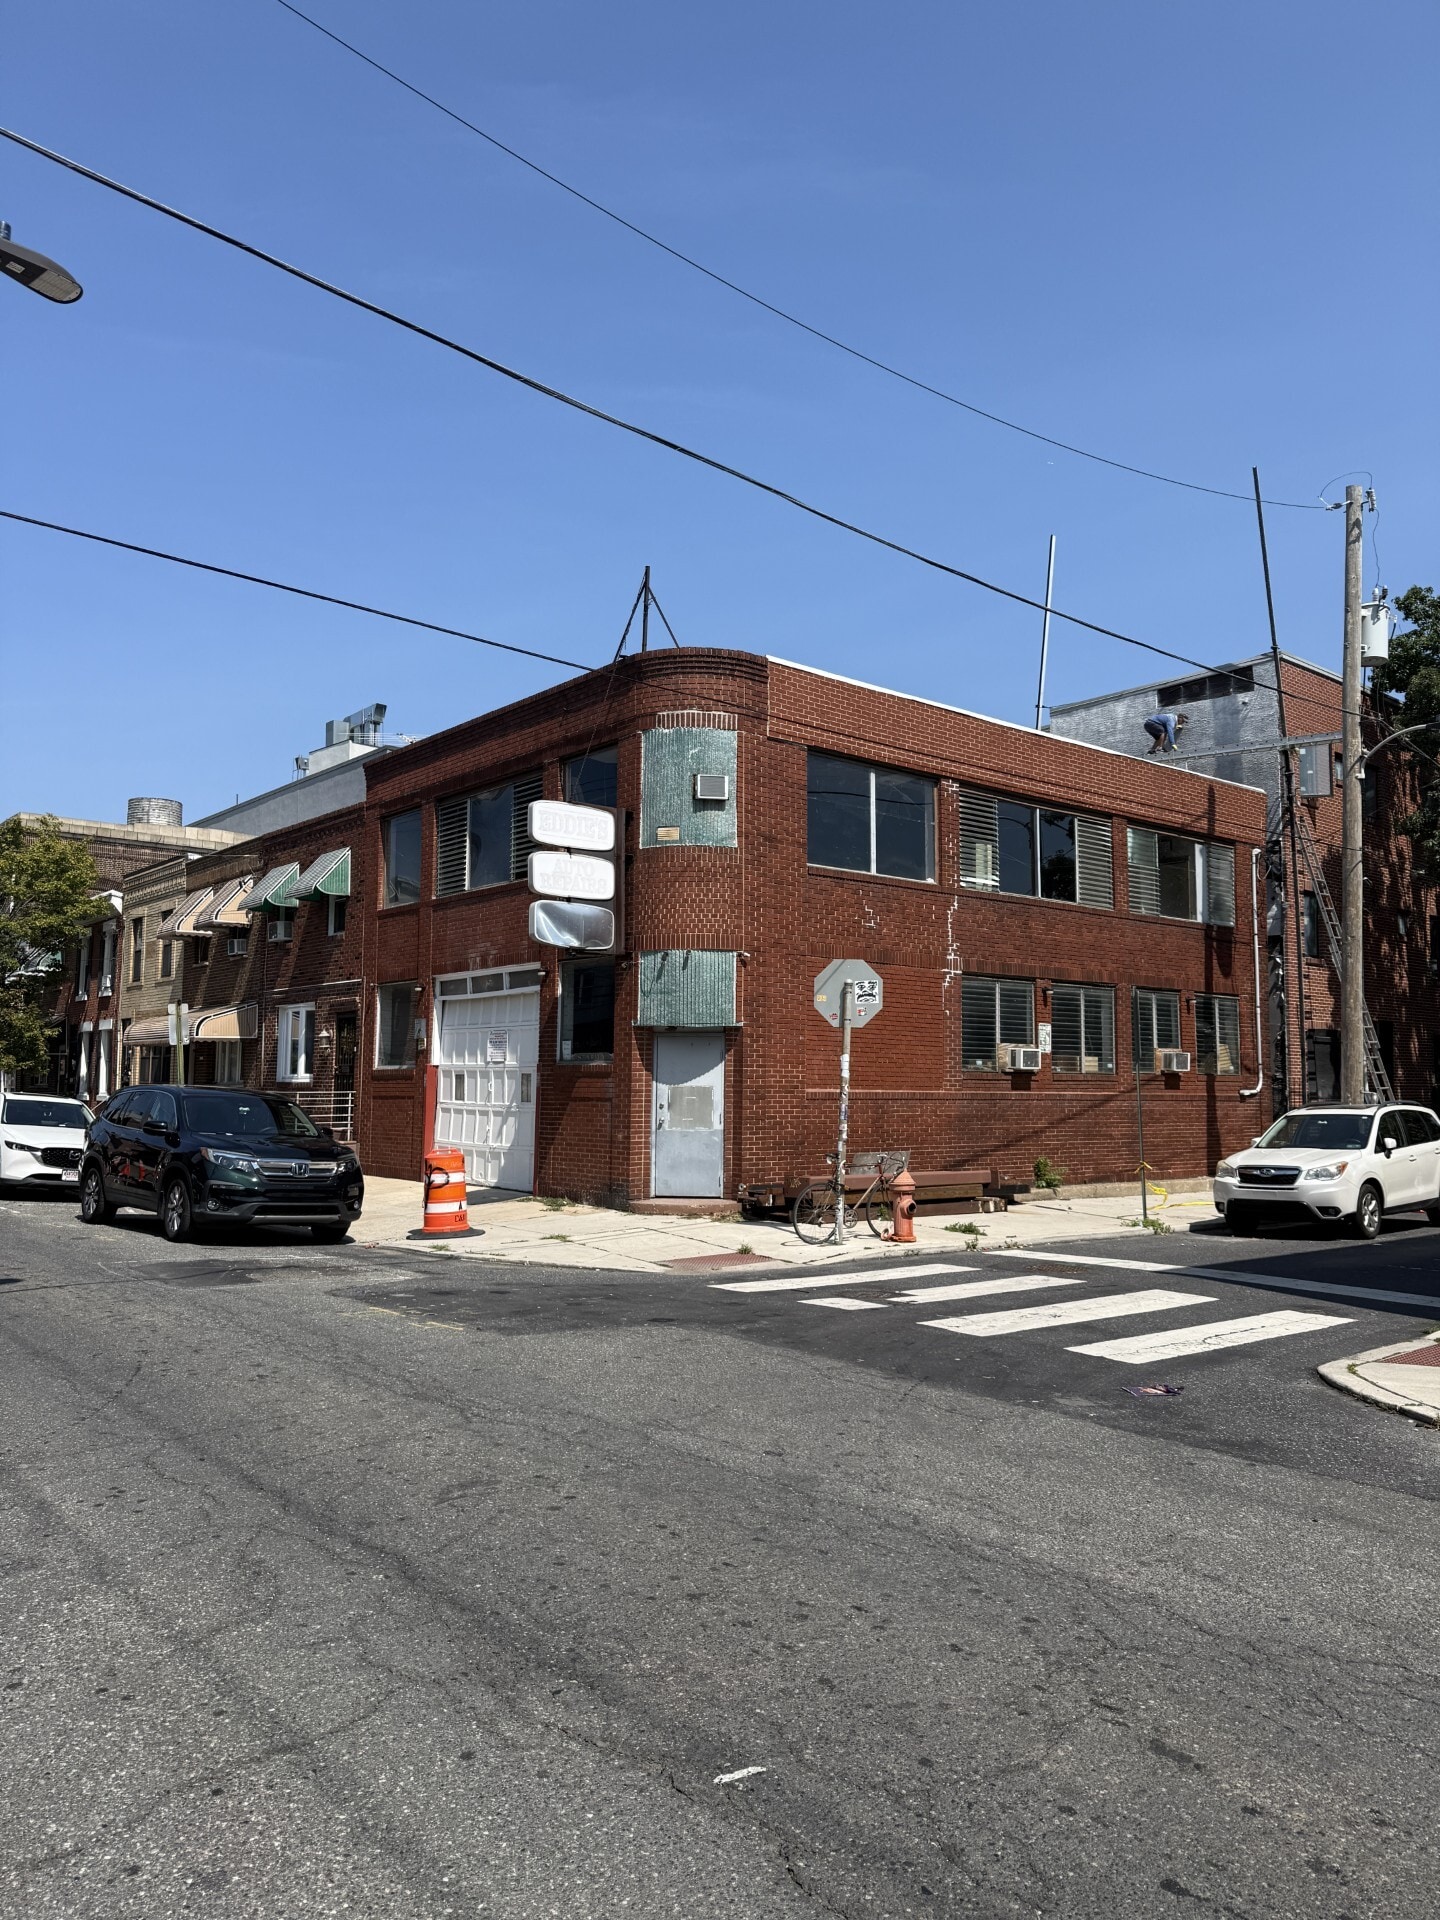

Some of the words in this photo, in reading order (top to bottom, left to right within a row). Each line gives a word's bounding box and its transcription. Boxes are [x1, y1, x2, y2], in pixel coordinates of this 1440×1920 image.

[538, 810, 609, 840] EDDIE'S
[553, 858, 595, 877] AUTO
[539, 872, 607, 895] REPAIRS
